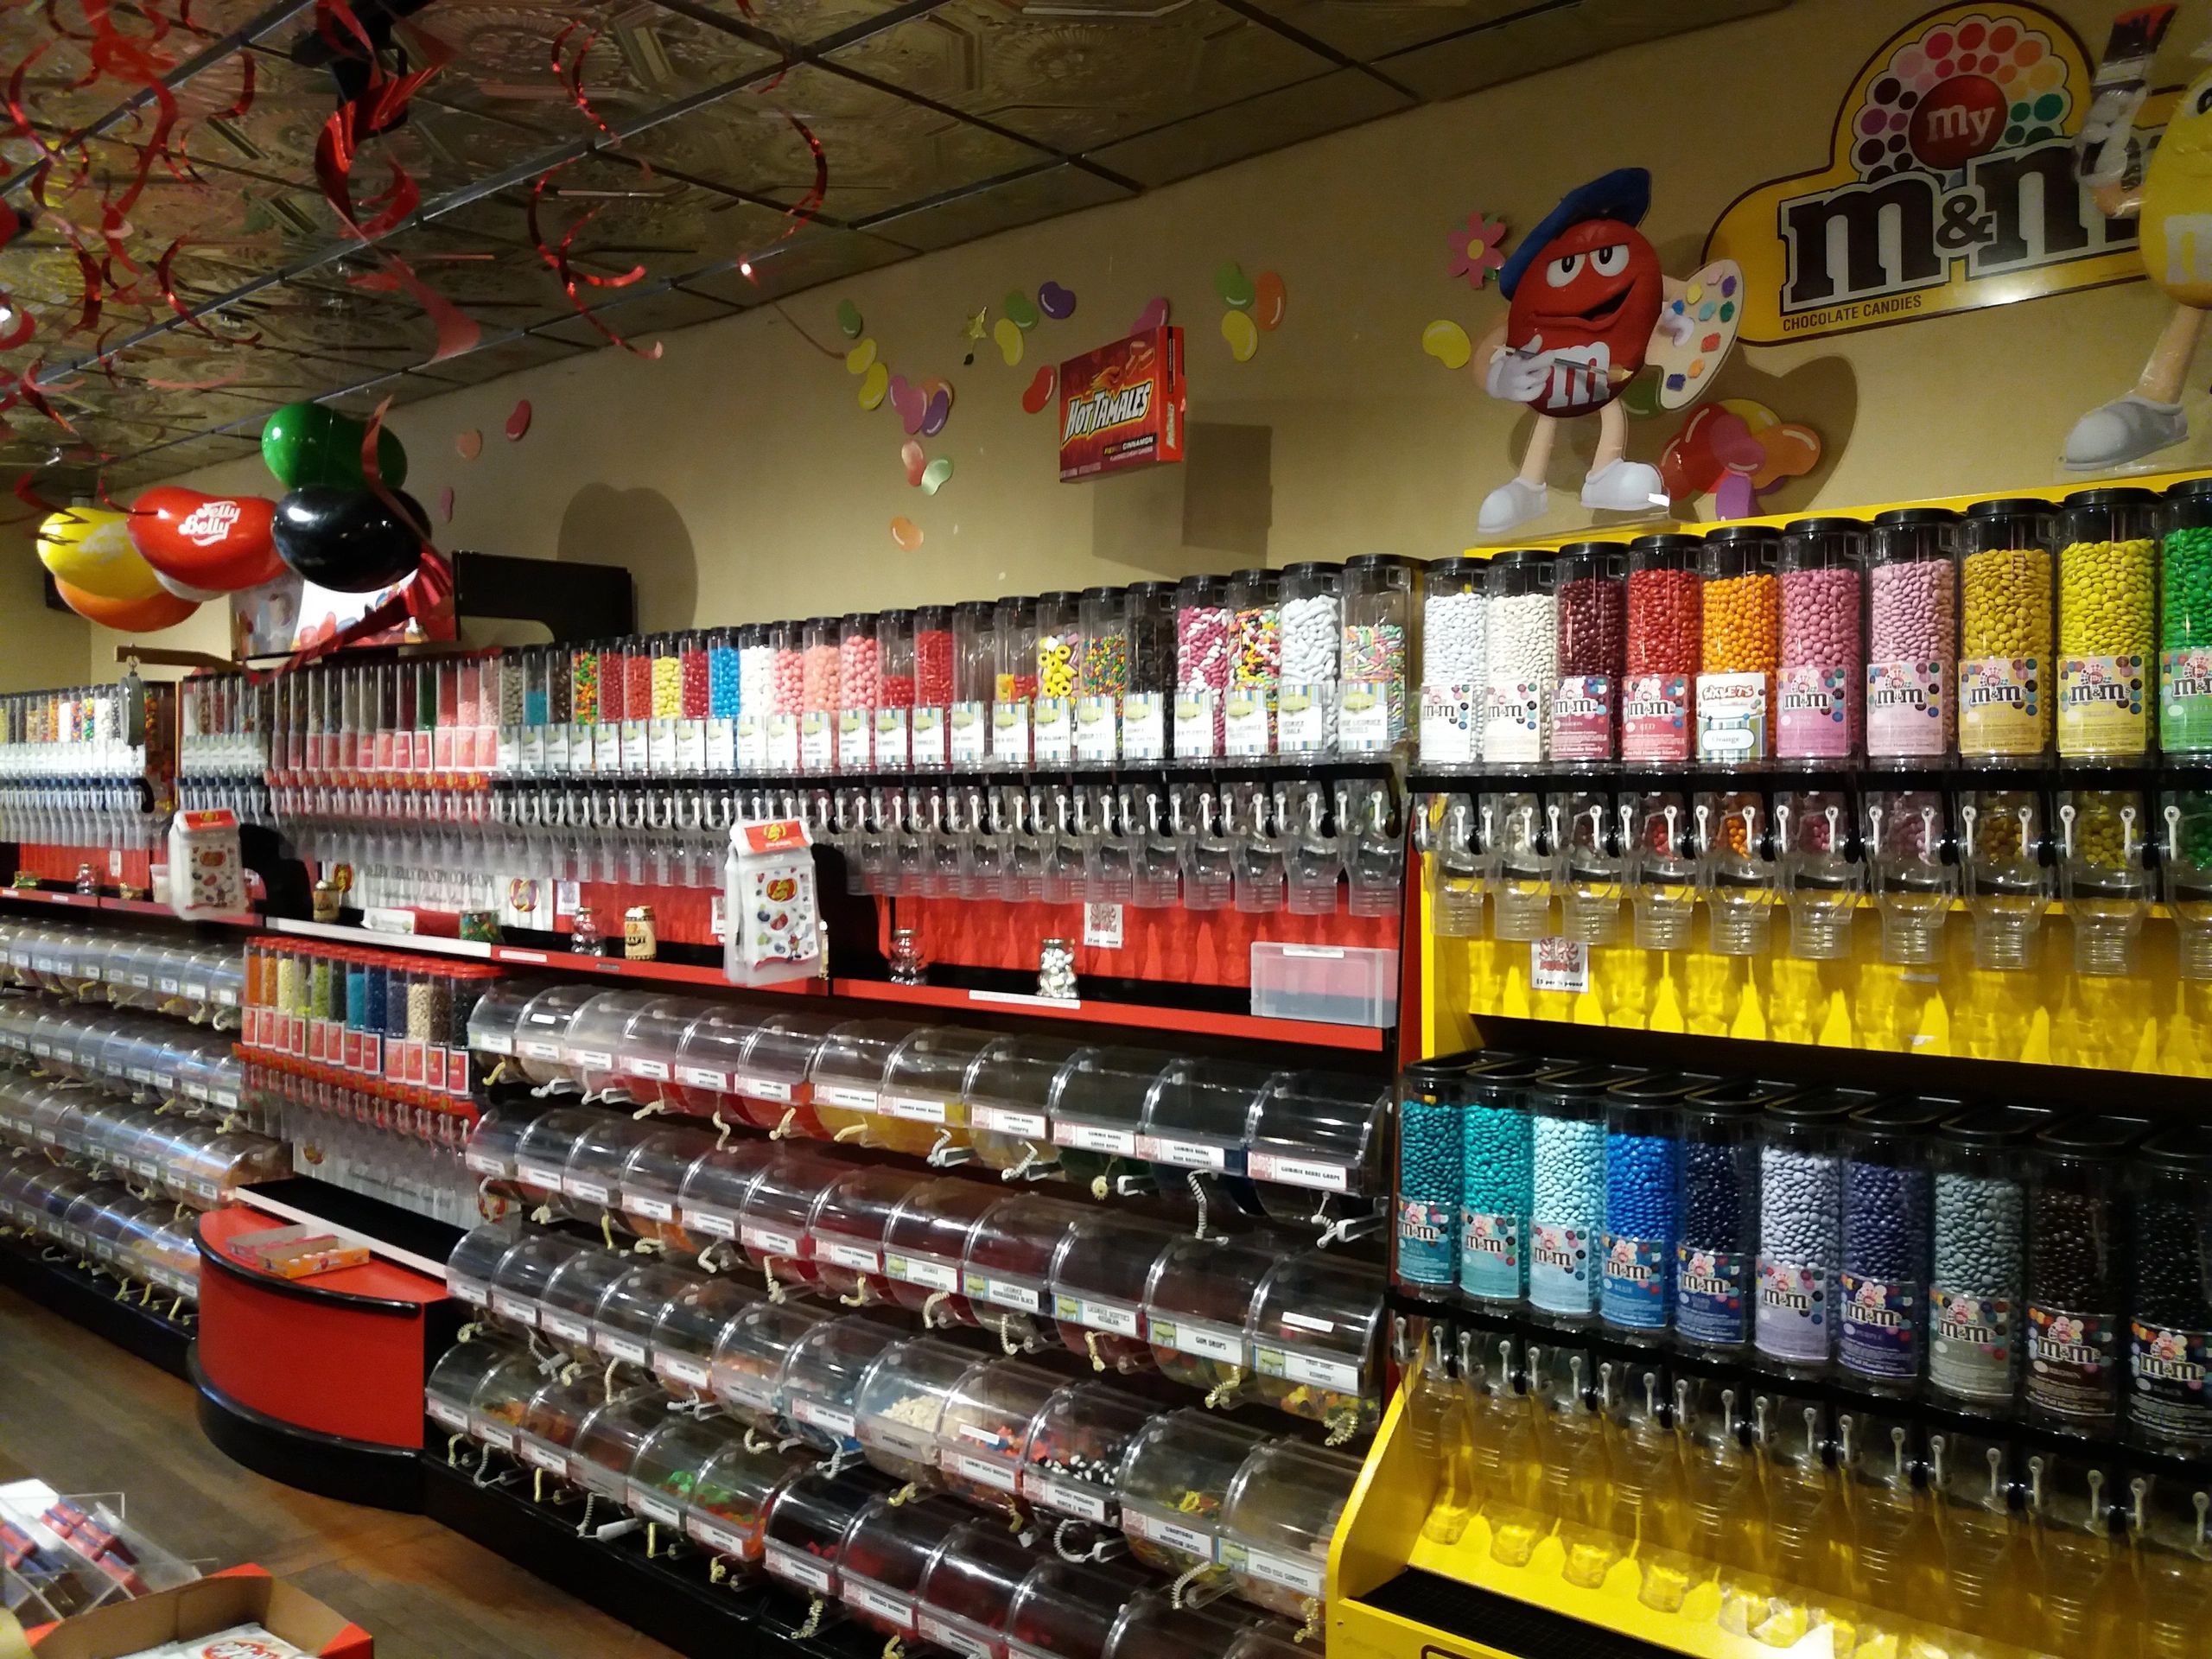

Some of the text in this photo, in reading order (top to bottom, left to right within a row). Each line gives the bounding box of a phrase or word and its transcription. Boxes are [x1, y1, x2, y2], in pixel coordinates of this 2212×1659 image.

[1926, 100, 1995, 144] my
[1782, 294, 1923, 333] CHOCOLATE CANDIES
[1088, 380, 1152, 434] TAMALES
[178, 514, 231, 546] Belly
[196, 501, 241, 524] Jelly
[1195, 1336, 1227, 1351] GUM DROPS
